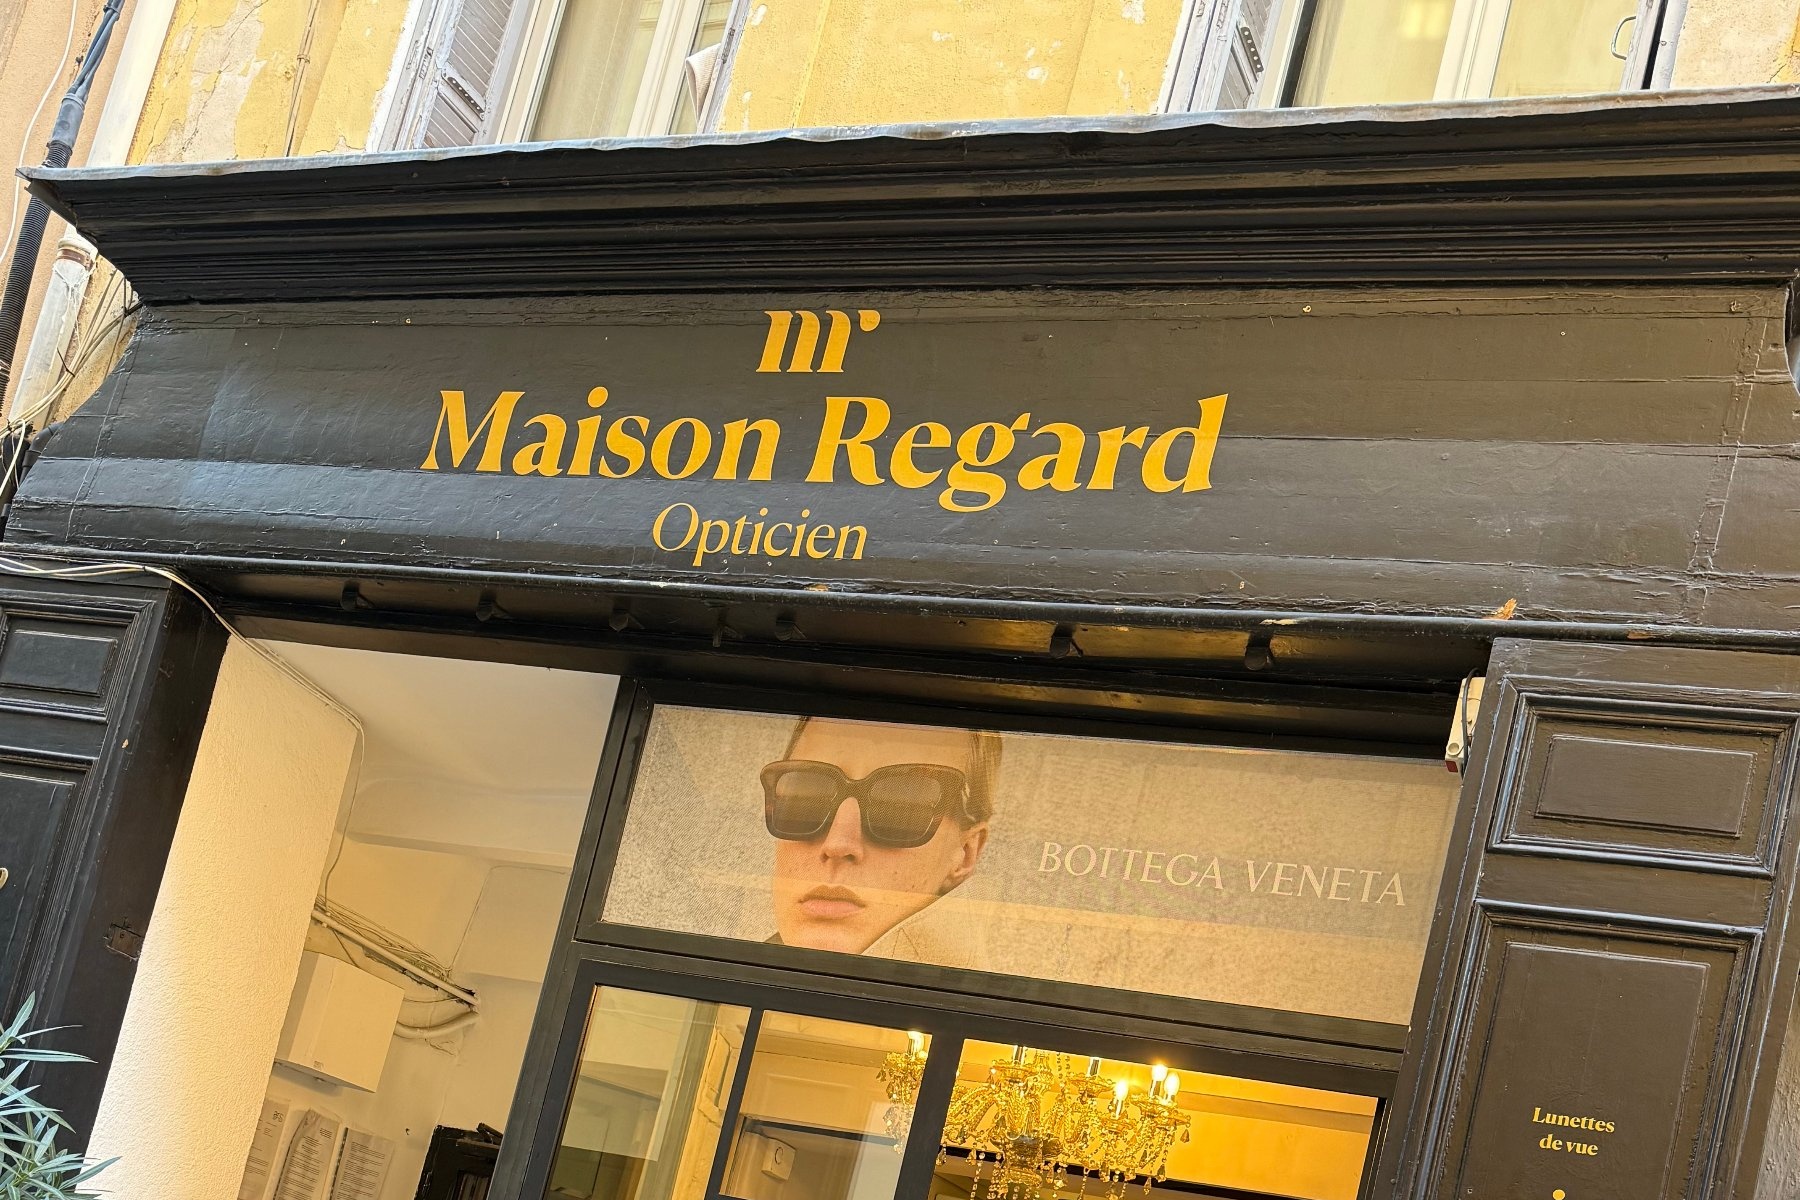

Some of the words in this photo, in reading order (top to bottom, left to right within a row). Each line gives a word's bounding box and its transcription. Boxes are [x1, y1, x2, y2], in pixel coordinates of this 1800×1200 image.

[420, 386, 784, 482] Maison
[805, 393, 1228, 513] Regard
[652, 503, 868, 567] Opticien
[1037, 841, 1225, 890] BOTTEGA
[1246, 859, 1406, 907] VENETA
[1532, 1107, 1616, 1133] Lunettes
[1539, 1134, 1563, 1151] de
[1566, 1141, 1599, 1156] vue
